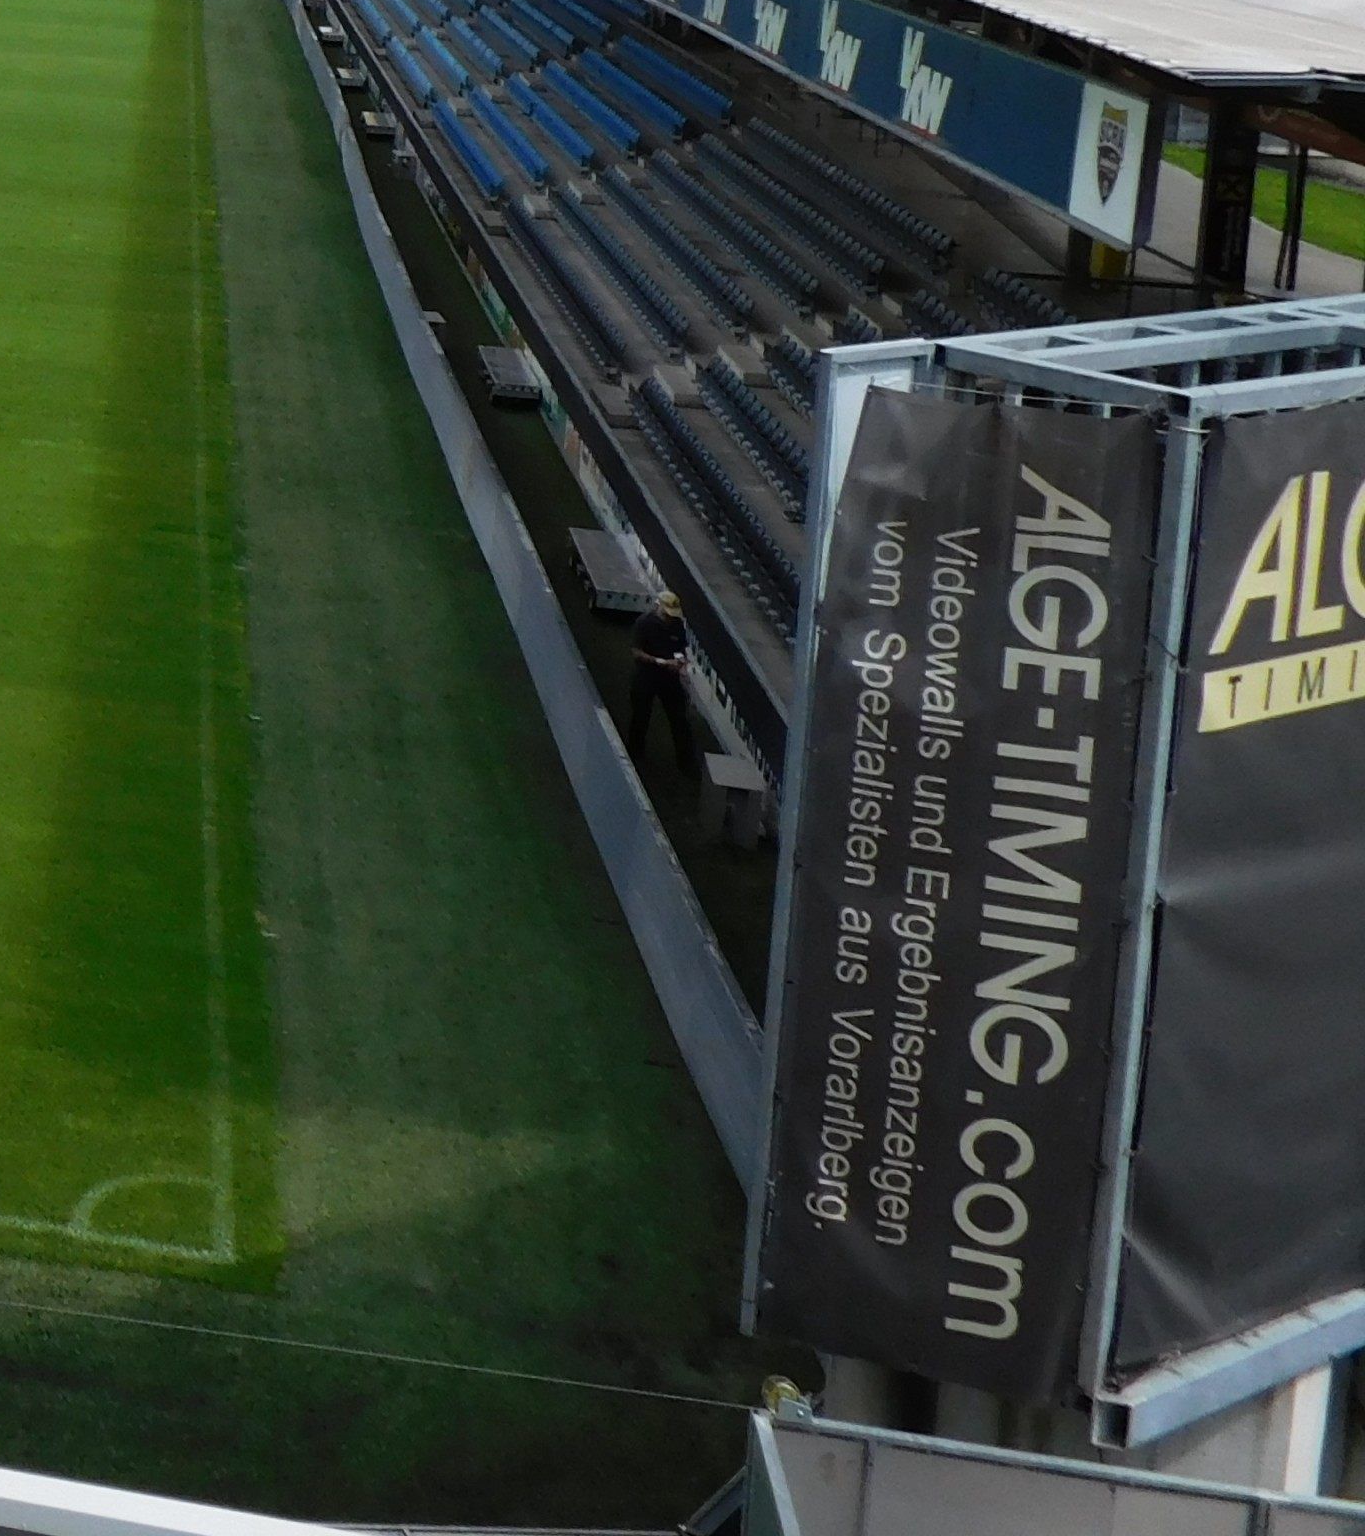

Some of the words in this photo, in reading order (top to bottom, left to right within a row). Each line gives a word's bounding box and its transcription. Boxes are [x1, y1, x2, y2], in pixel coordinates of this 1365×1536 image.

[868, 519, 908, 608] vom
[918, 527, 980, 760] Videowalls
[842, 628, 907, 888] Spezialisten
[905, 774, 951, 854] und
[835, 906, 872, 985] aus
[944, 463, 1111, 1340] ALGE-TIMING.com
[804, 1008, 875, 1230] Vorarlberg.
[869, 866, 950, 1246] Ergebnisanzeigen
